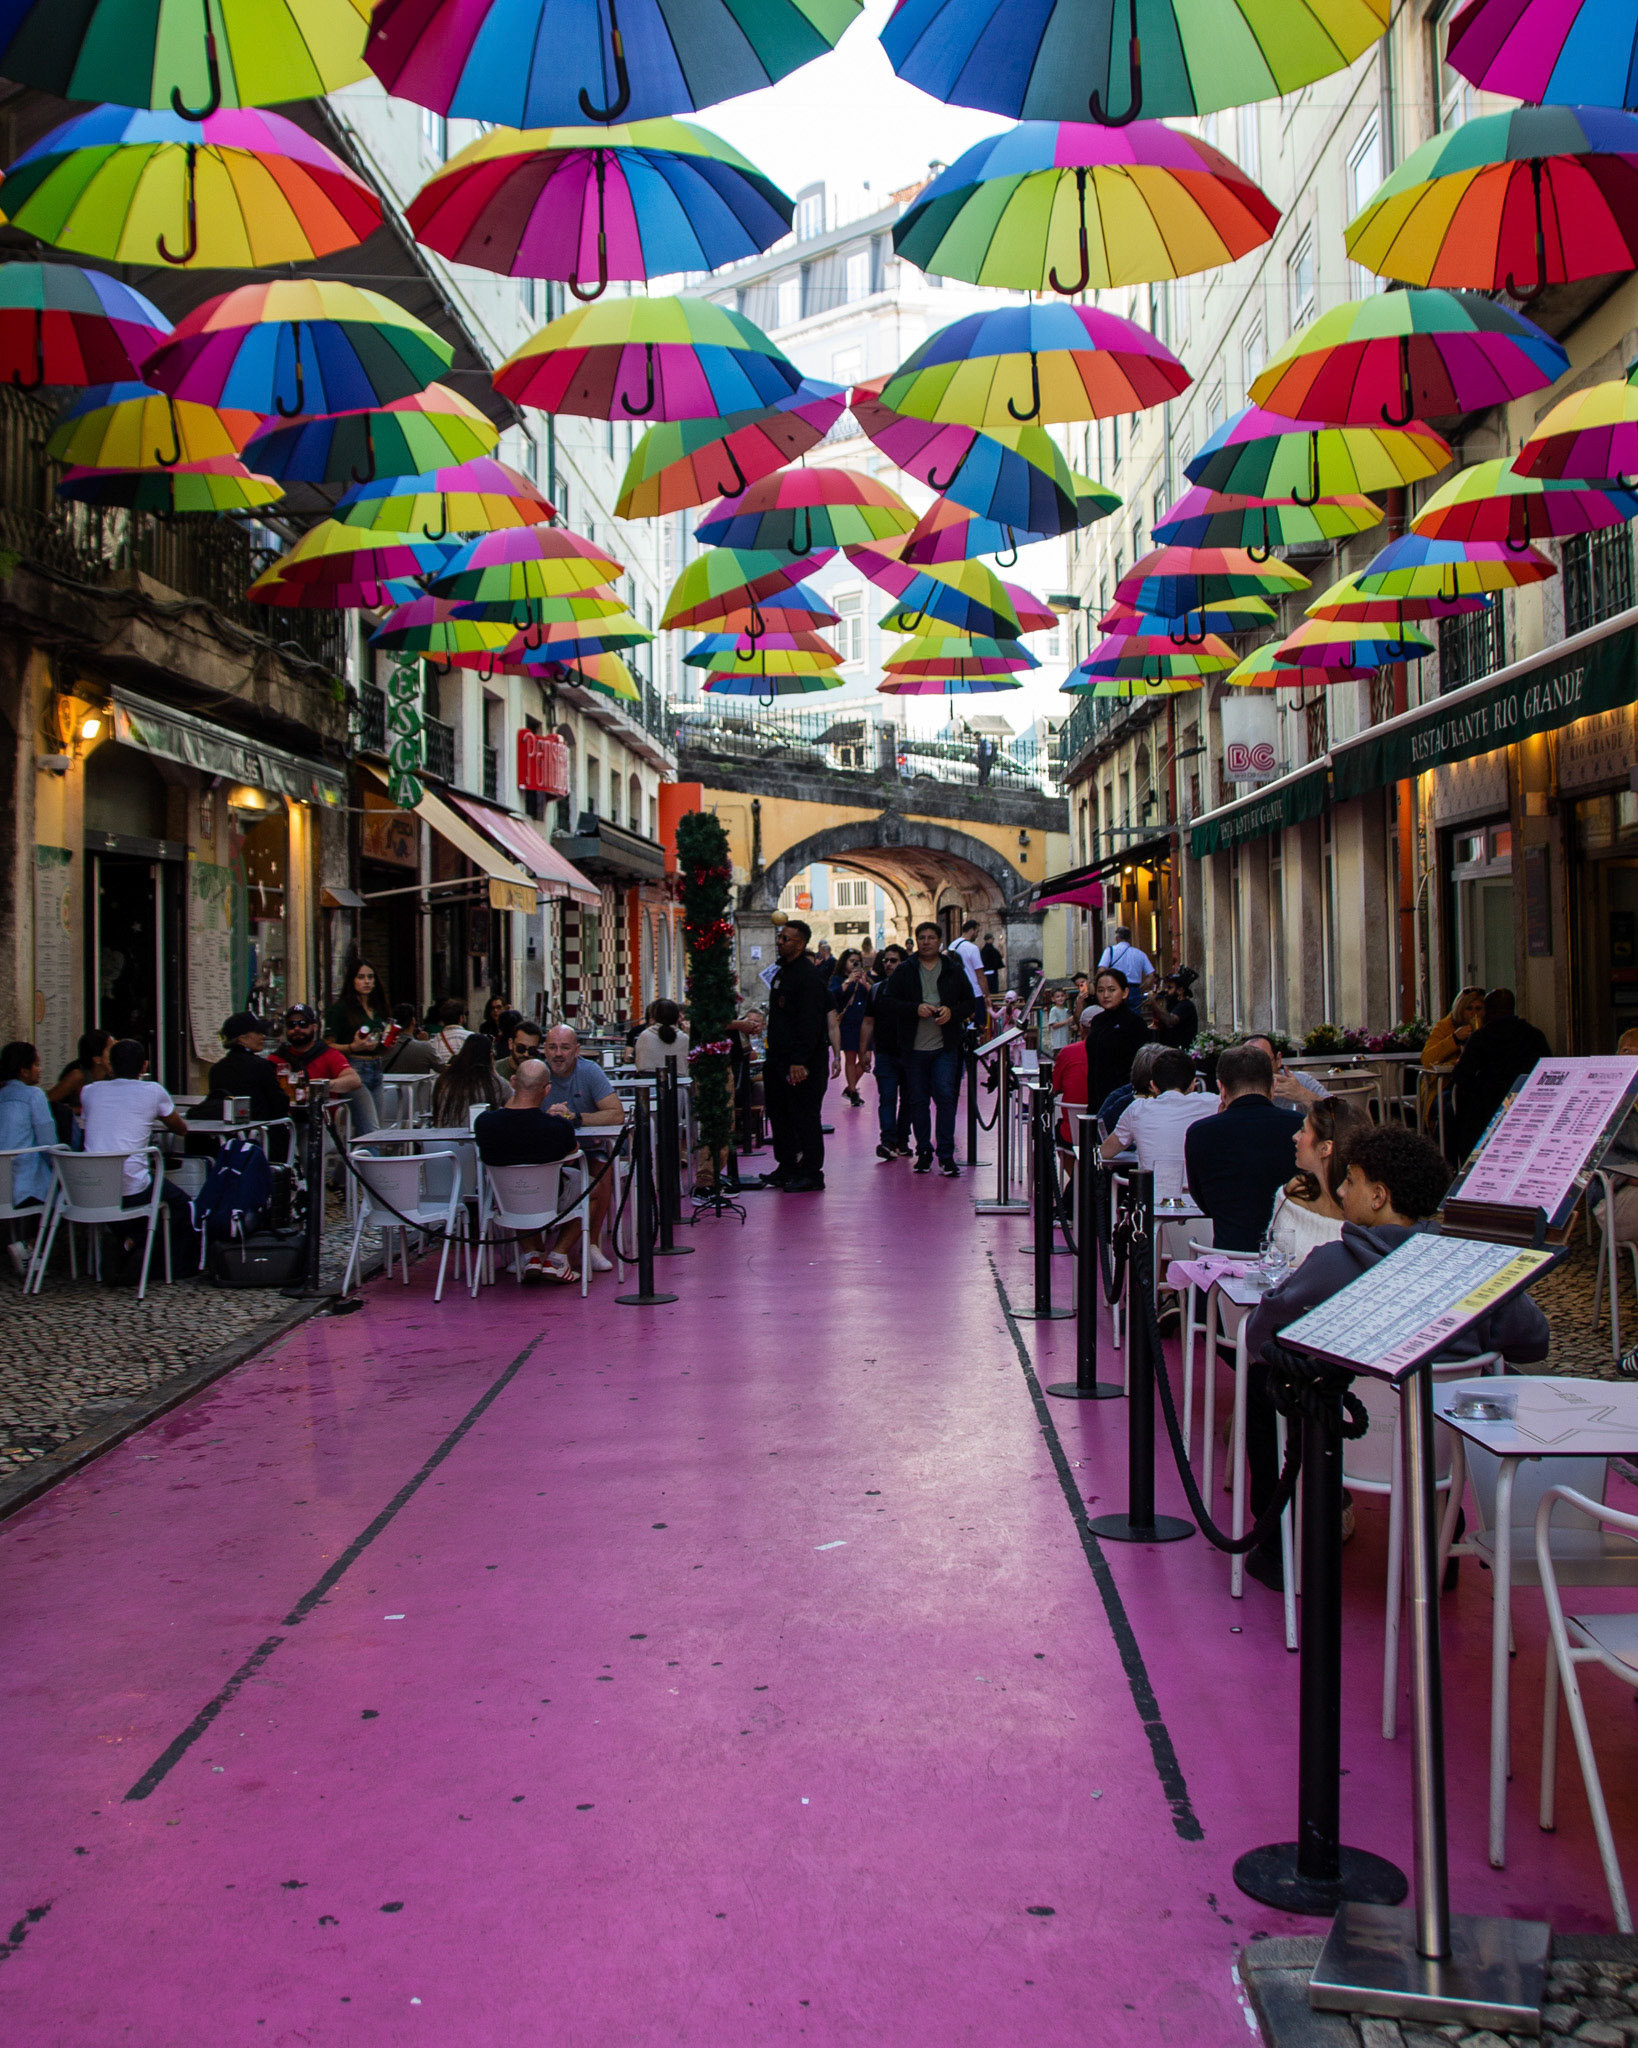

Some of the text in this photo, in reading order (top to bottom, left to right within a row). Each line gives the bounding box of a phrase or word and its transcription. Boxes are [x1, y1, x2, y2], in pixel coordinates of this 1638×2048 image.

[395, 650, 415, 803] ESCA
[1227, 743, 1275, 772] BC
[1411, 667, 1585, 762] RESTAURANTE RIO GRANDE
